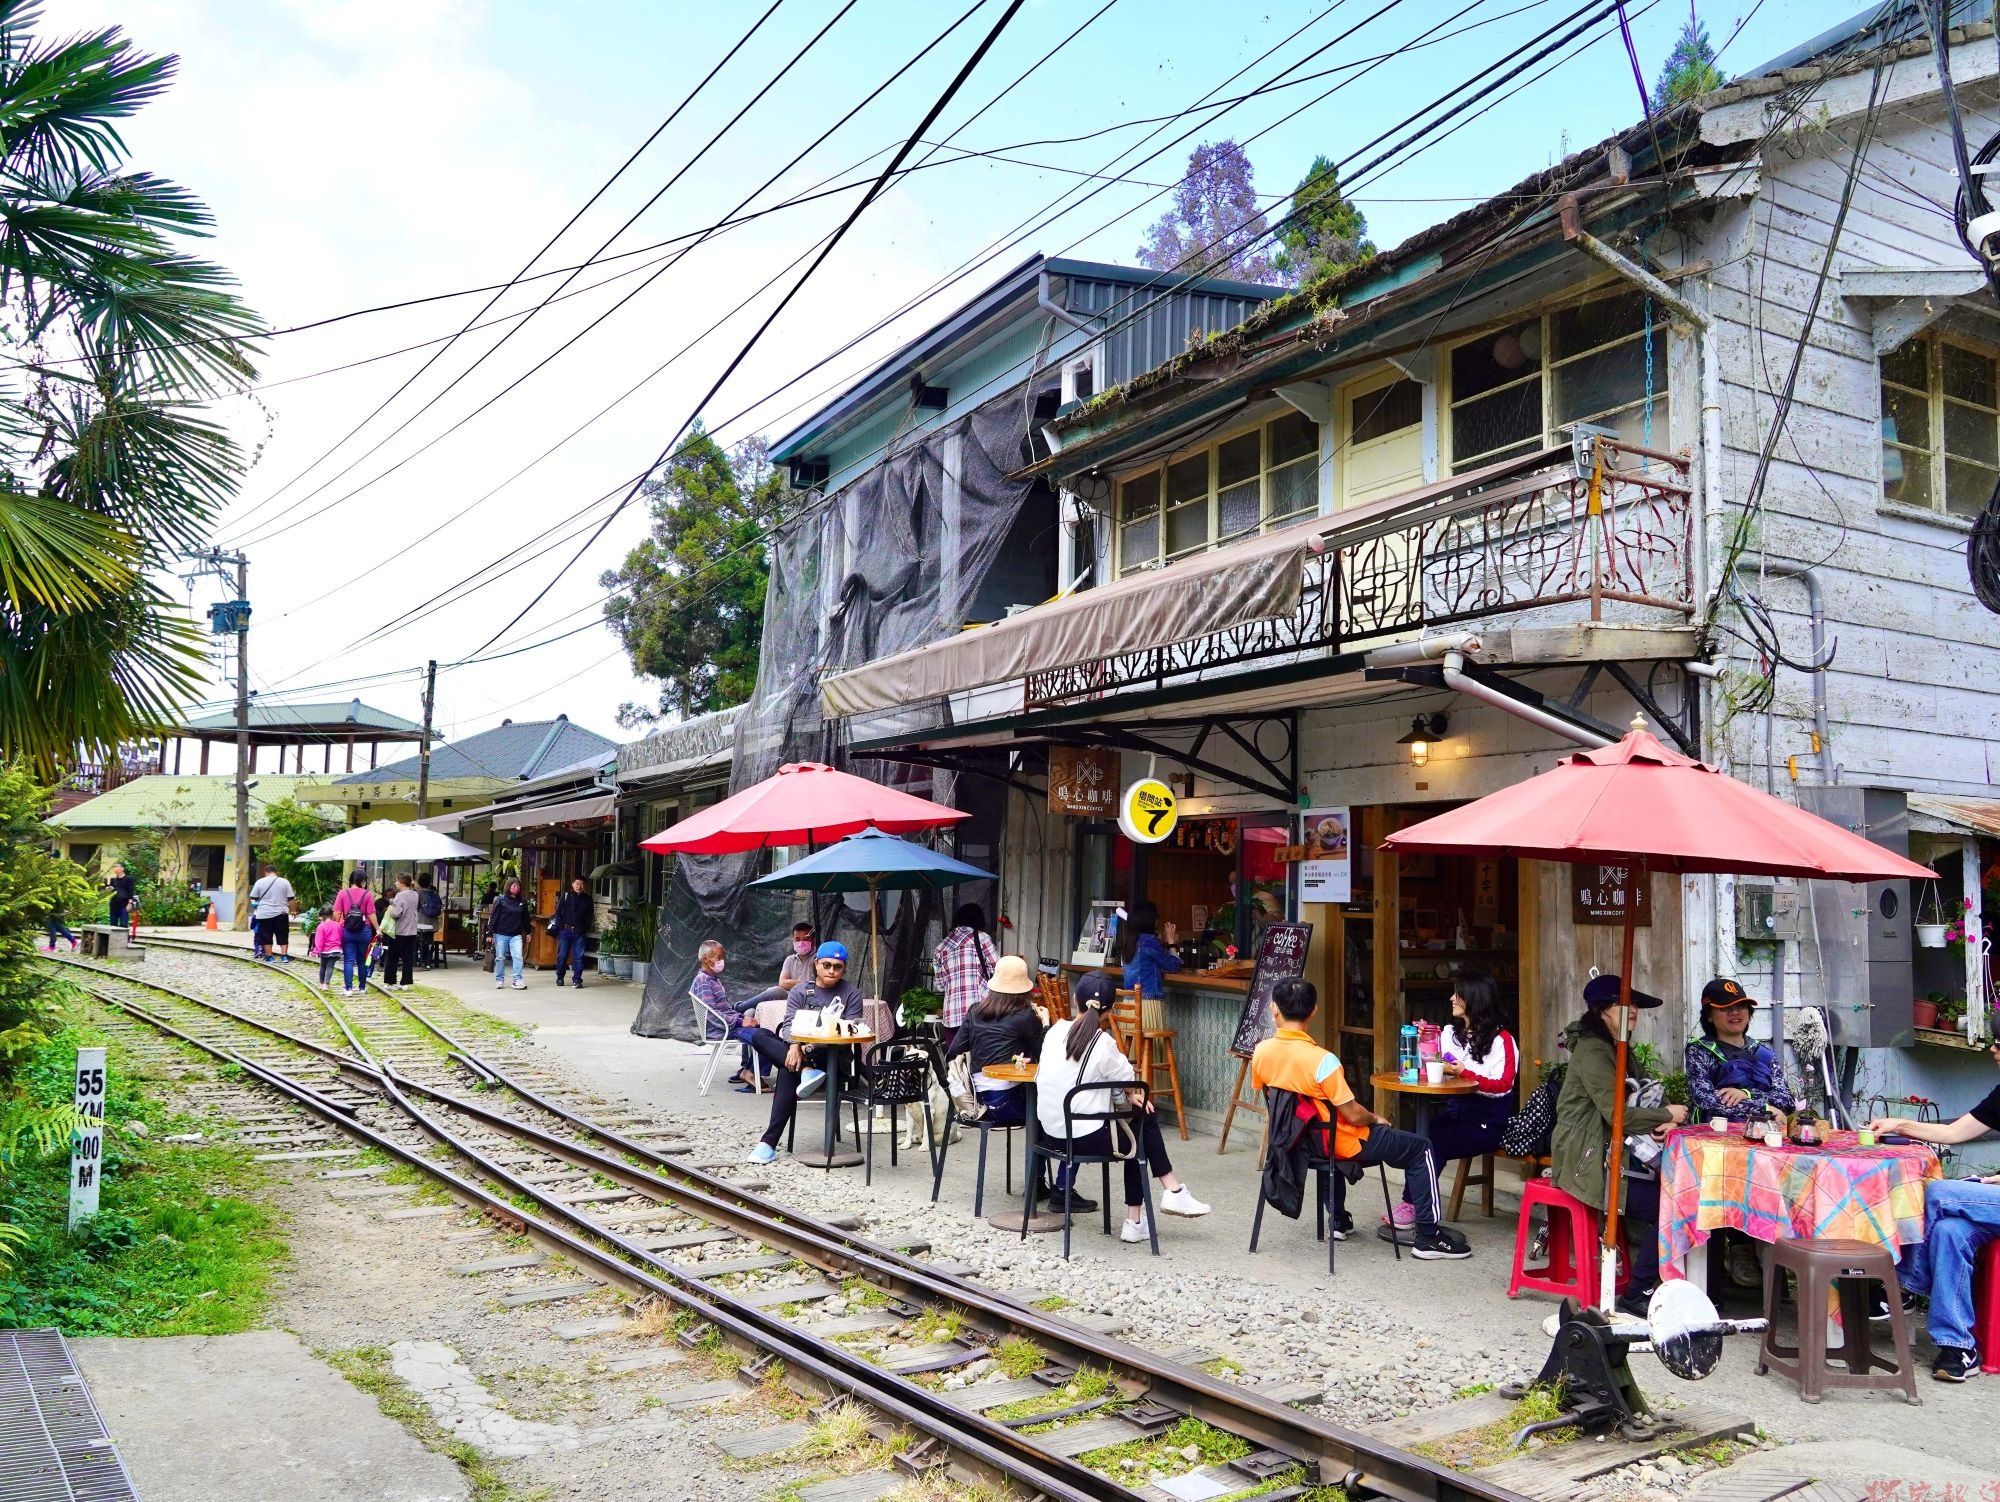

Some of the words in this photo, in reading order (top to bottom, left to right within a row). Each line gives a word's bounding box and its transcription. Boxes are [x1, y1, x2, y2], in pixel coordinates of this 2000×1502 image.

[1058, 785, 1113, 805] 鳴心咖啡
[78, 1069, 104, 1097] 55
[78, 1164, 94, 1188] M
